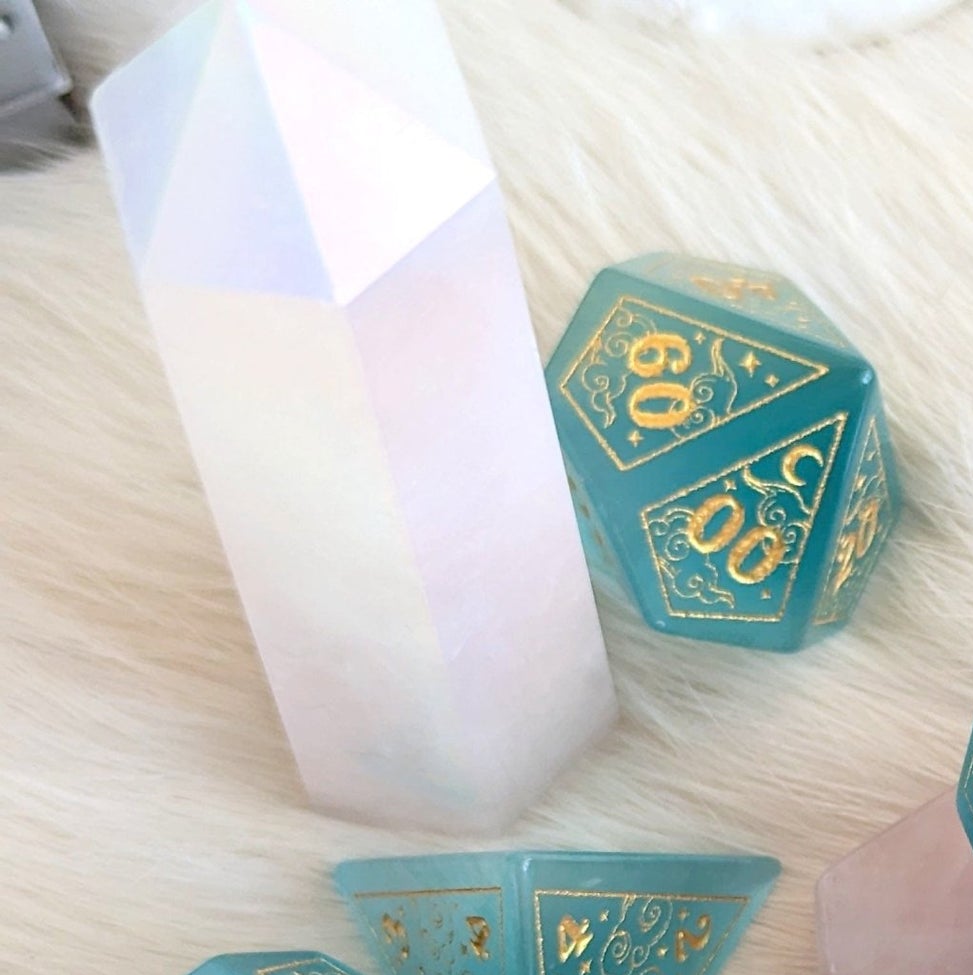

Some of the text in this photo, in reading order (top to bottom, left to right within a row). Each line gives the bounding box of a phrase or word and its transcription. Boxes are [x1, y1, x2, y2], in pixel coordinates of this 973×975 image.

[628, 333, 695, 430] 60
[687, 493, 786, 585] 00
[558, 915, 595, 963] 4
[673, 914, 712, 962] 2
